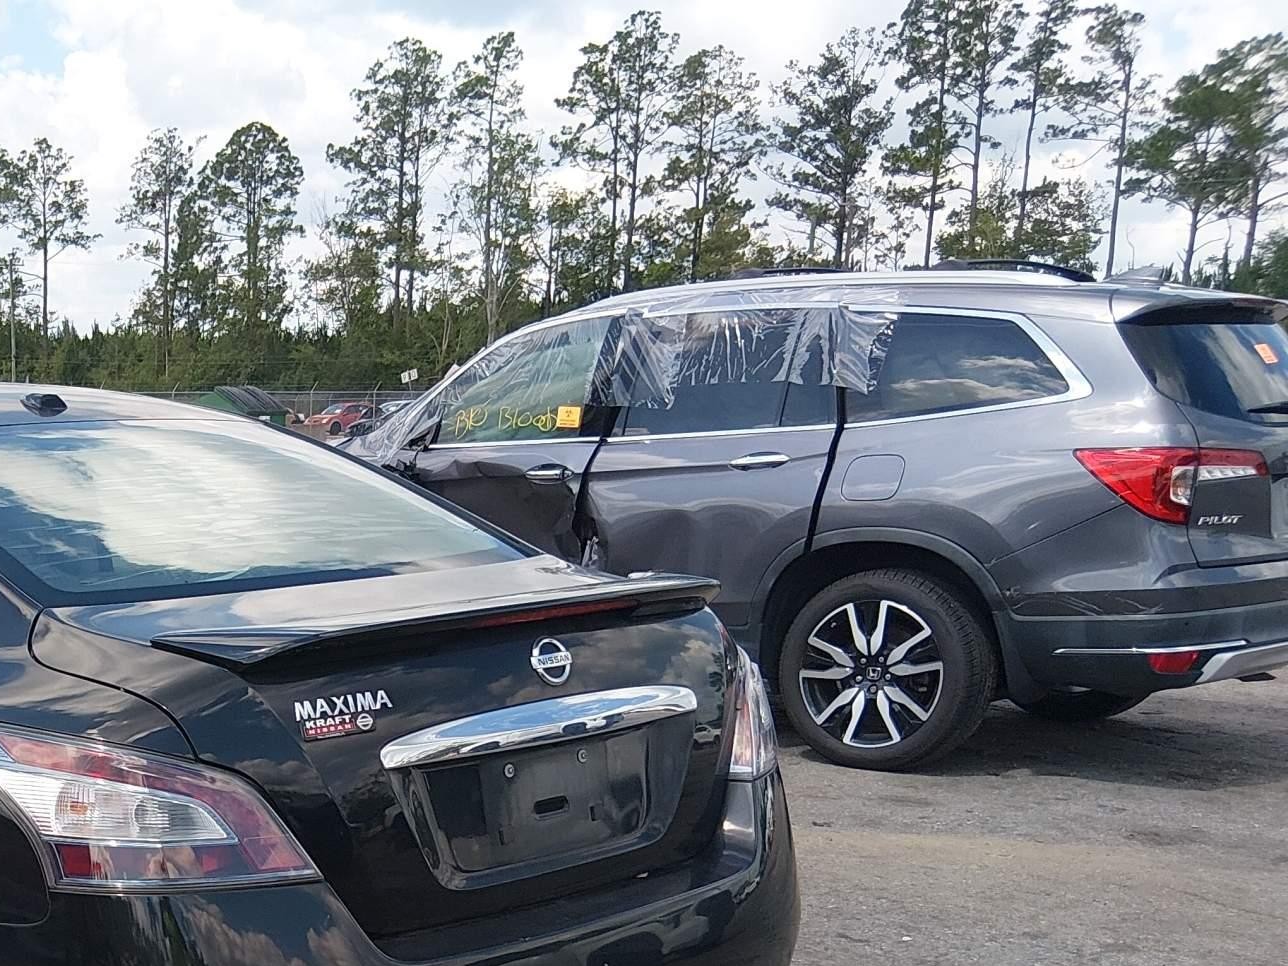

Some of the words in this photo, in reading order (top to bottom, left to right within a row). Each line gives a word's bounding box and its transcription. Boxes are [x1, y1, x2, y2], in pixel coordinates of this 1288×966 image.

[1197, 514, 1243, 526] PILOT
[536, 654, 570, 666] NISSAN
[294, 690, 393, 722] MAXIMA
[305, 714, 352, 729] KRAFT
[306, 724, 352, 736] NISSAN
